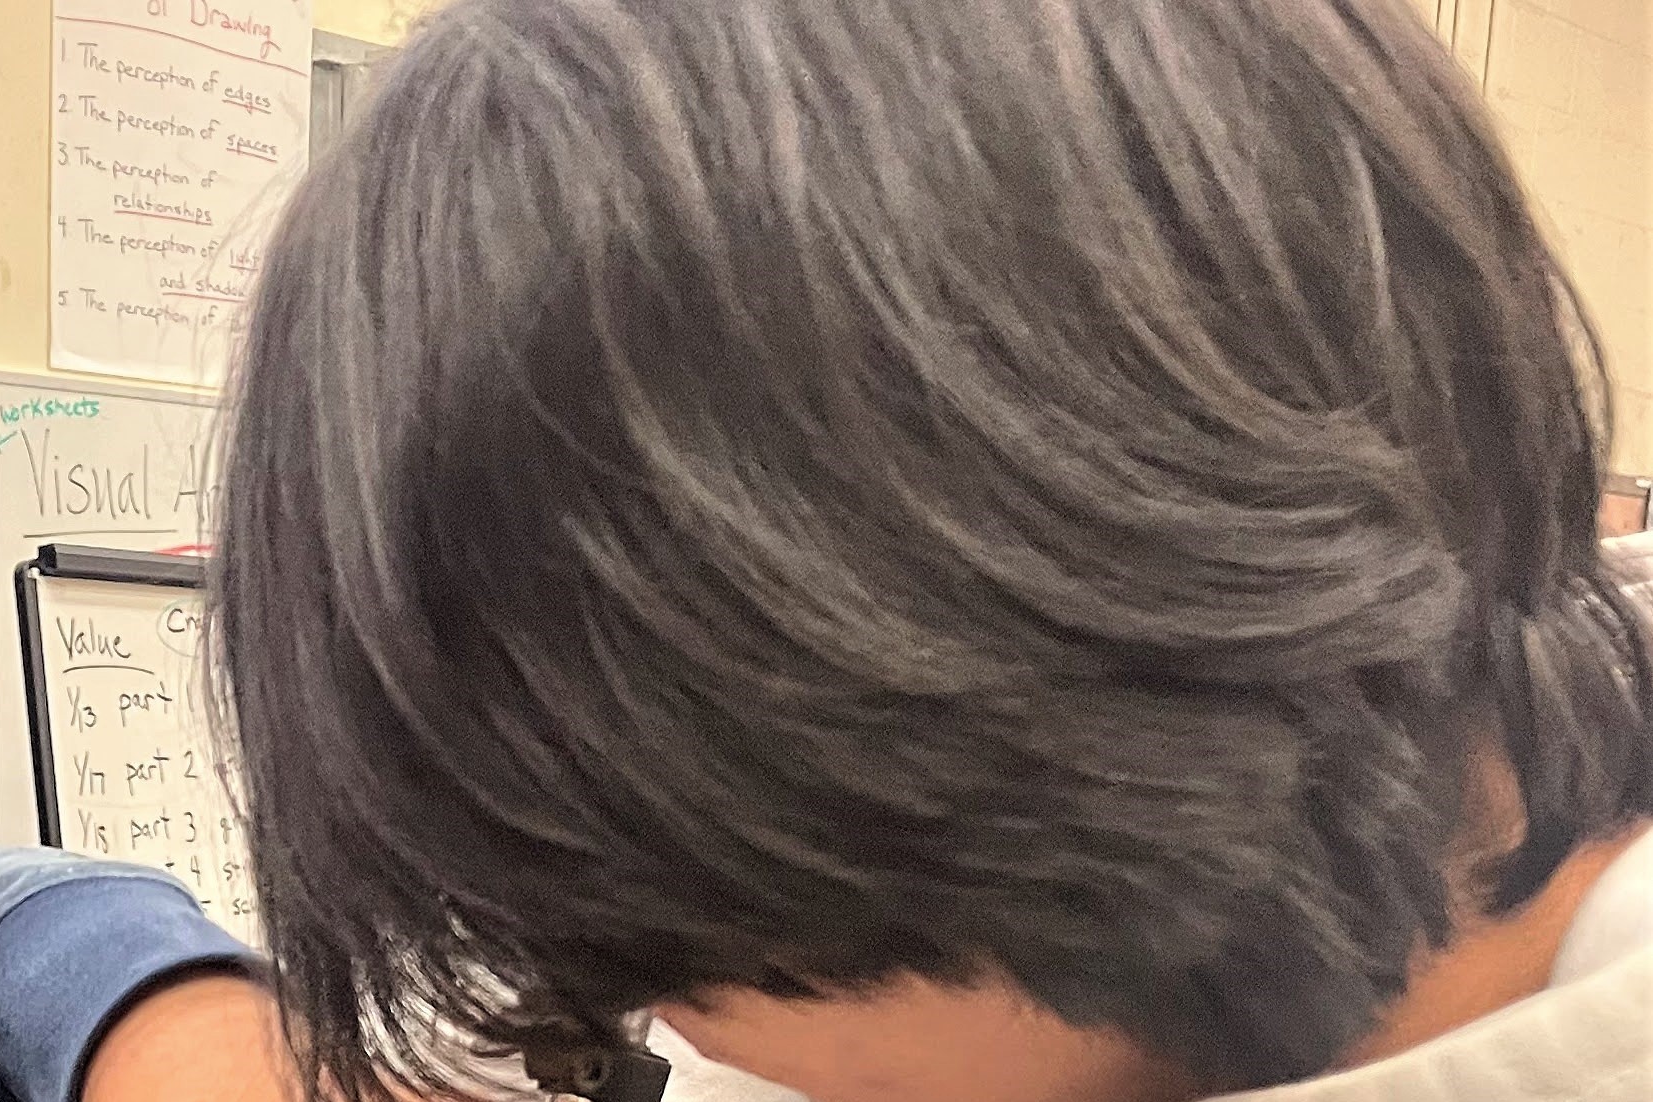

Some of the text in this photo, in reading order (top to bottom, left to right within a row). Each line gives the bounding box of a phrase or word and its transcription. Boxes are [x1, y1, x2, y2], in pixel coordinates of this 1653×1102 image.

[77, 41, 112, 74] The
[115, 59, 196, 90] perception
[201, 70, 220, 93] of
[224, 84, 272, 116] edges
[78, 95, 112, 122] The
[117, 109, 195, 140] perception
[199, 119, 221, 140] of
[227, 133, 279, 157] spaces
[74, 146, 107, 171] The
[112, 159, 189, 187] perception
[201, 169, 218, 189] of
[113, 191, 213, 224] relationships
[77, 218, 114, 246] The
[119, 233, 195, 260] perception
[200, 239, 220, 258] of
[159, 271, 187, 290] and
[79, 287, 108, 313] The
[116, 301, 190, 327] perception
[201, 305, 218, 325] of
[19, 427, 152, 520] Visual
[56, 615, 132, 661] Value
[118, 681, 173, 728] part
[125, 746, 170, 797] part
[183, 749, 199, 779] 2
[130, 806, 171, 850] part
[183, 811, 198, 843] 3
